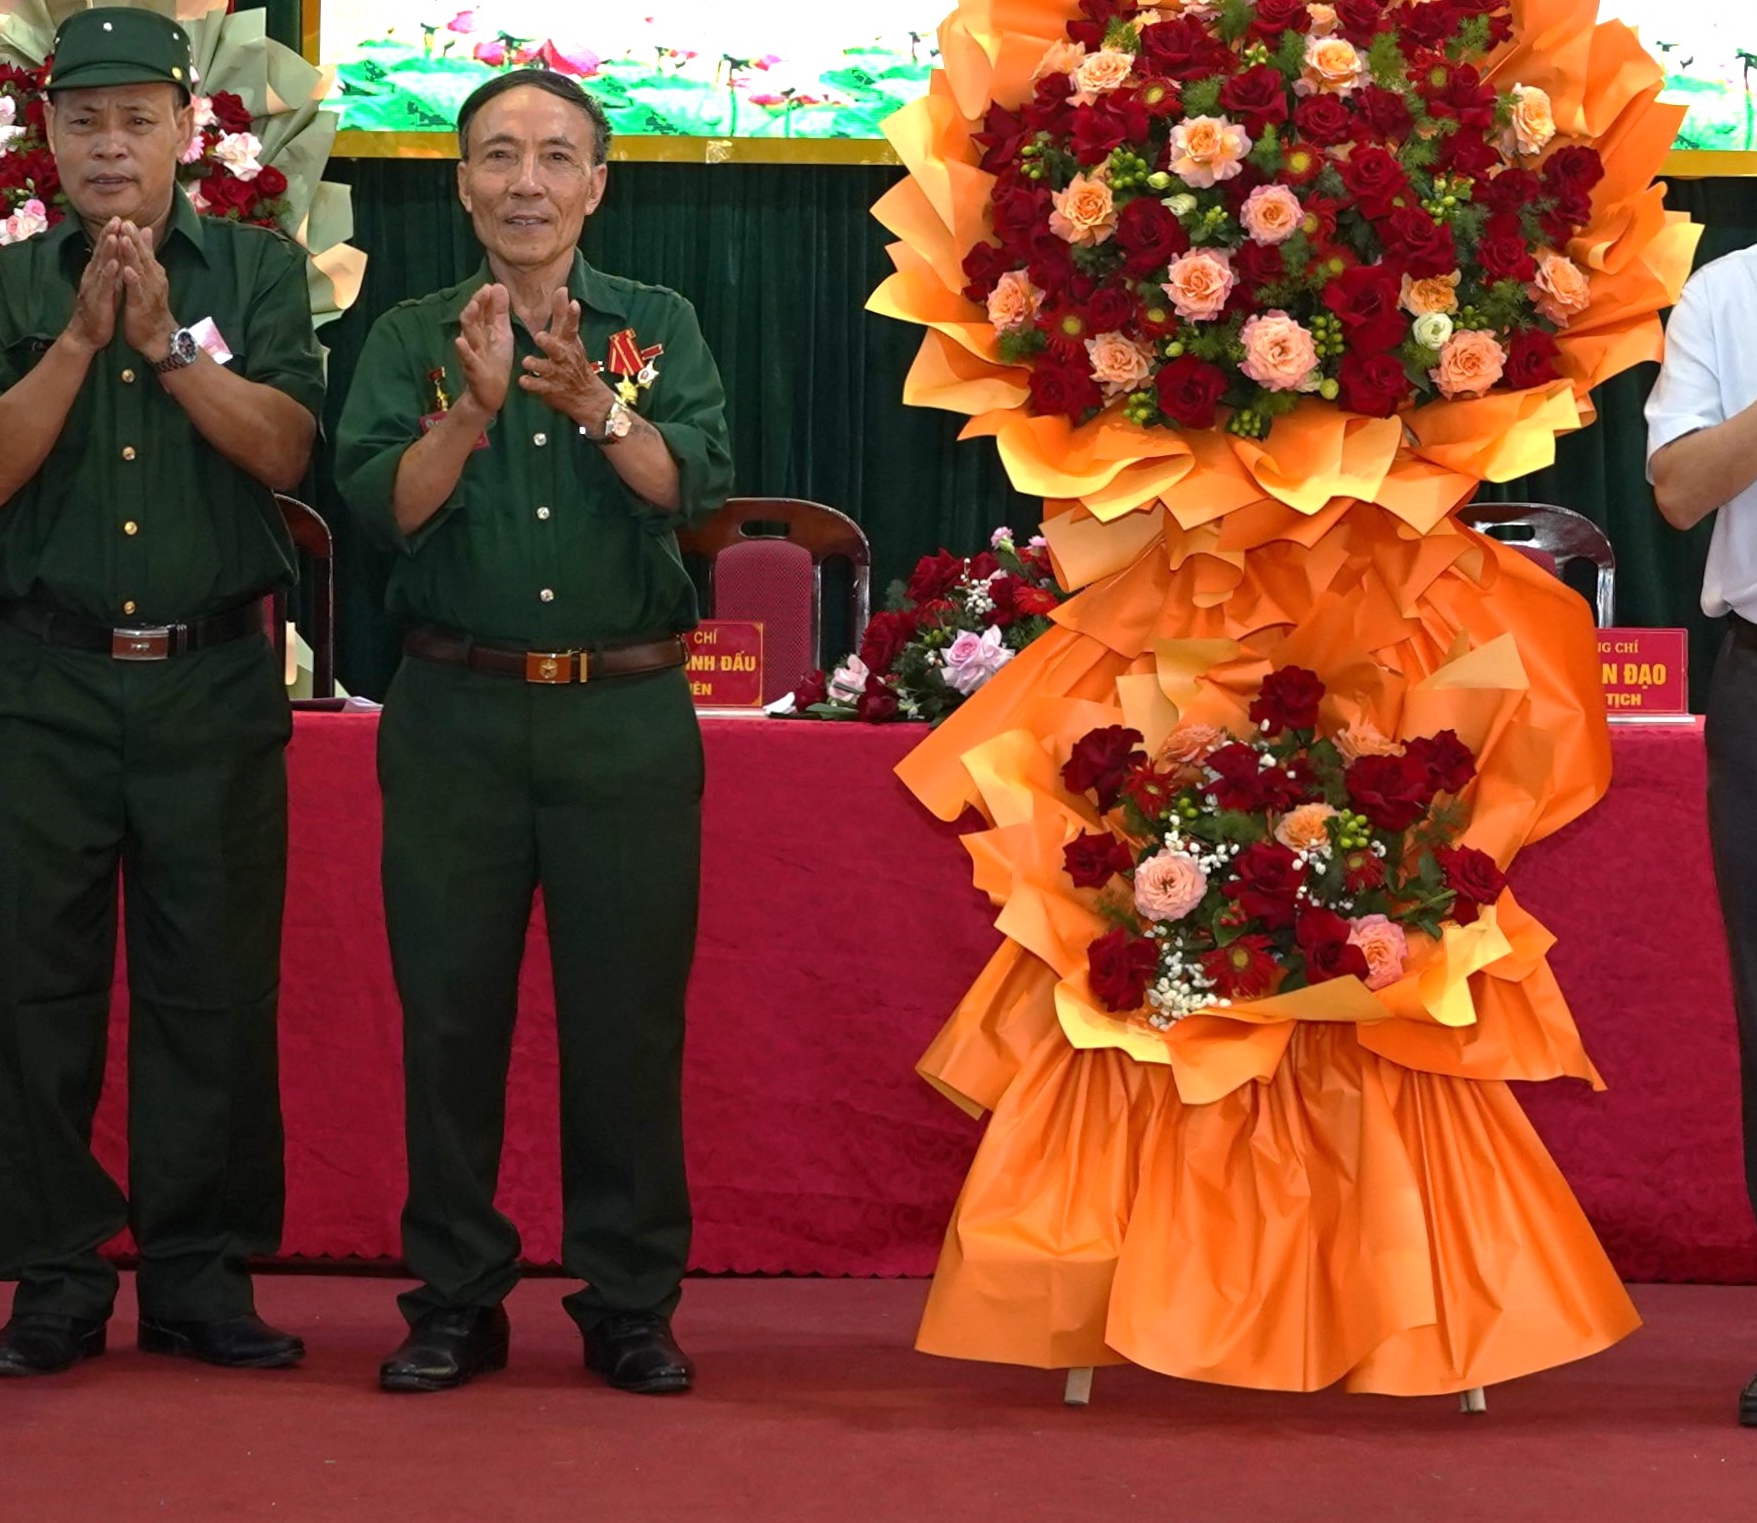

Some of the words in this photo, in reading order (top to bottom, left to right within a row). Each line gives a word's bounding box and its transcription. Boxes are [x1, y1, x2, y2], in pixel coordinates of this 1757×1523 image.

[694, 628, 718, 644] CHÍ
[1615, 639, 1638, 653] CHÍ
[720, 650, 756, 672] ĐẤU
[1624, 663, 1666, 689] ĐẠO
[1605, 693, 1641, 708] TỊCH
